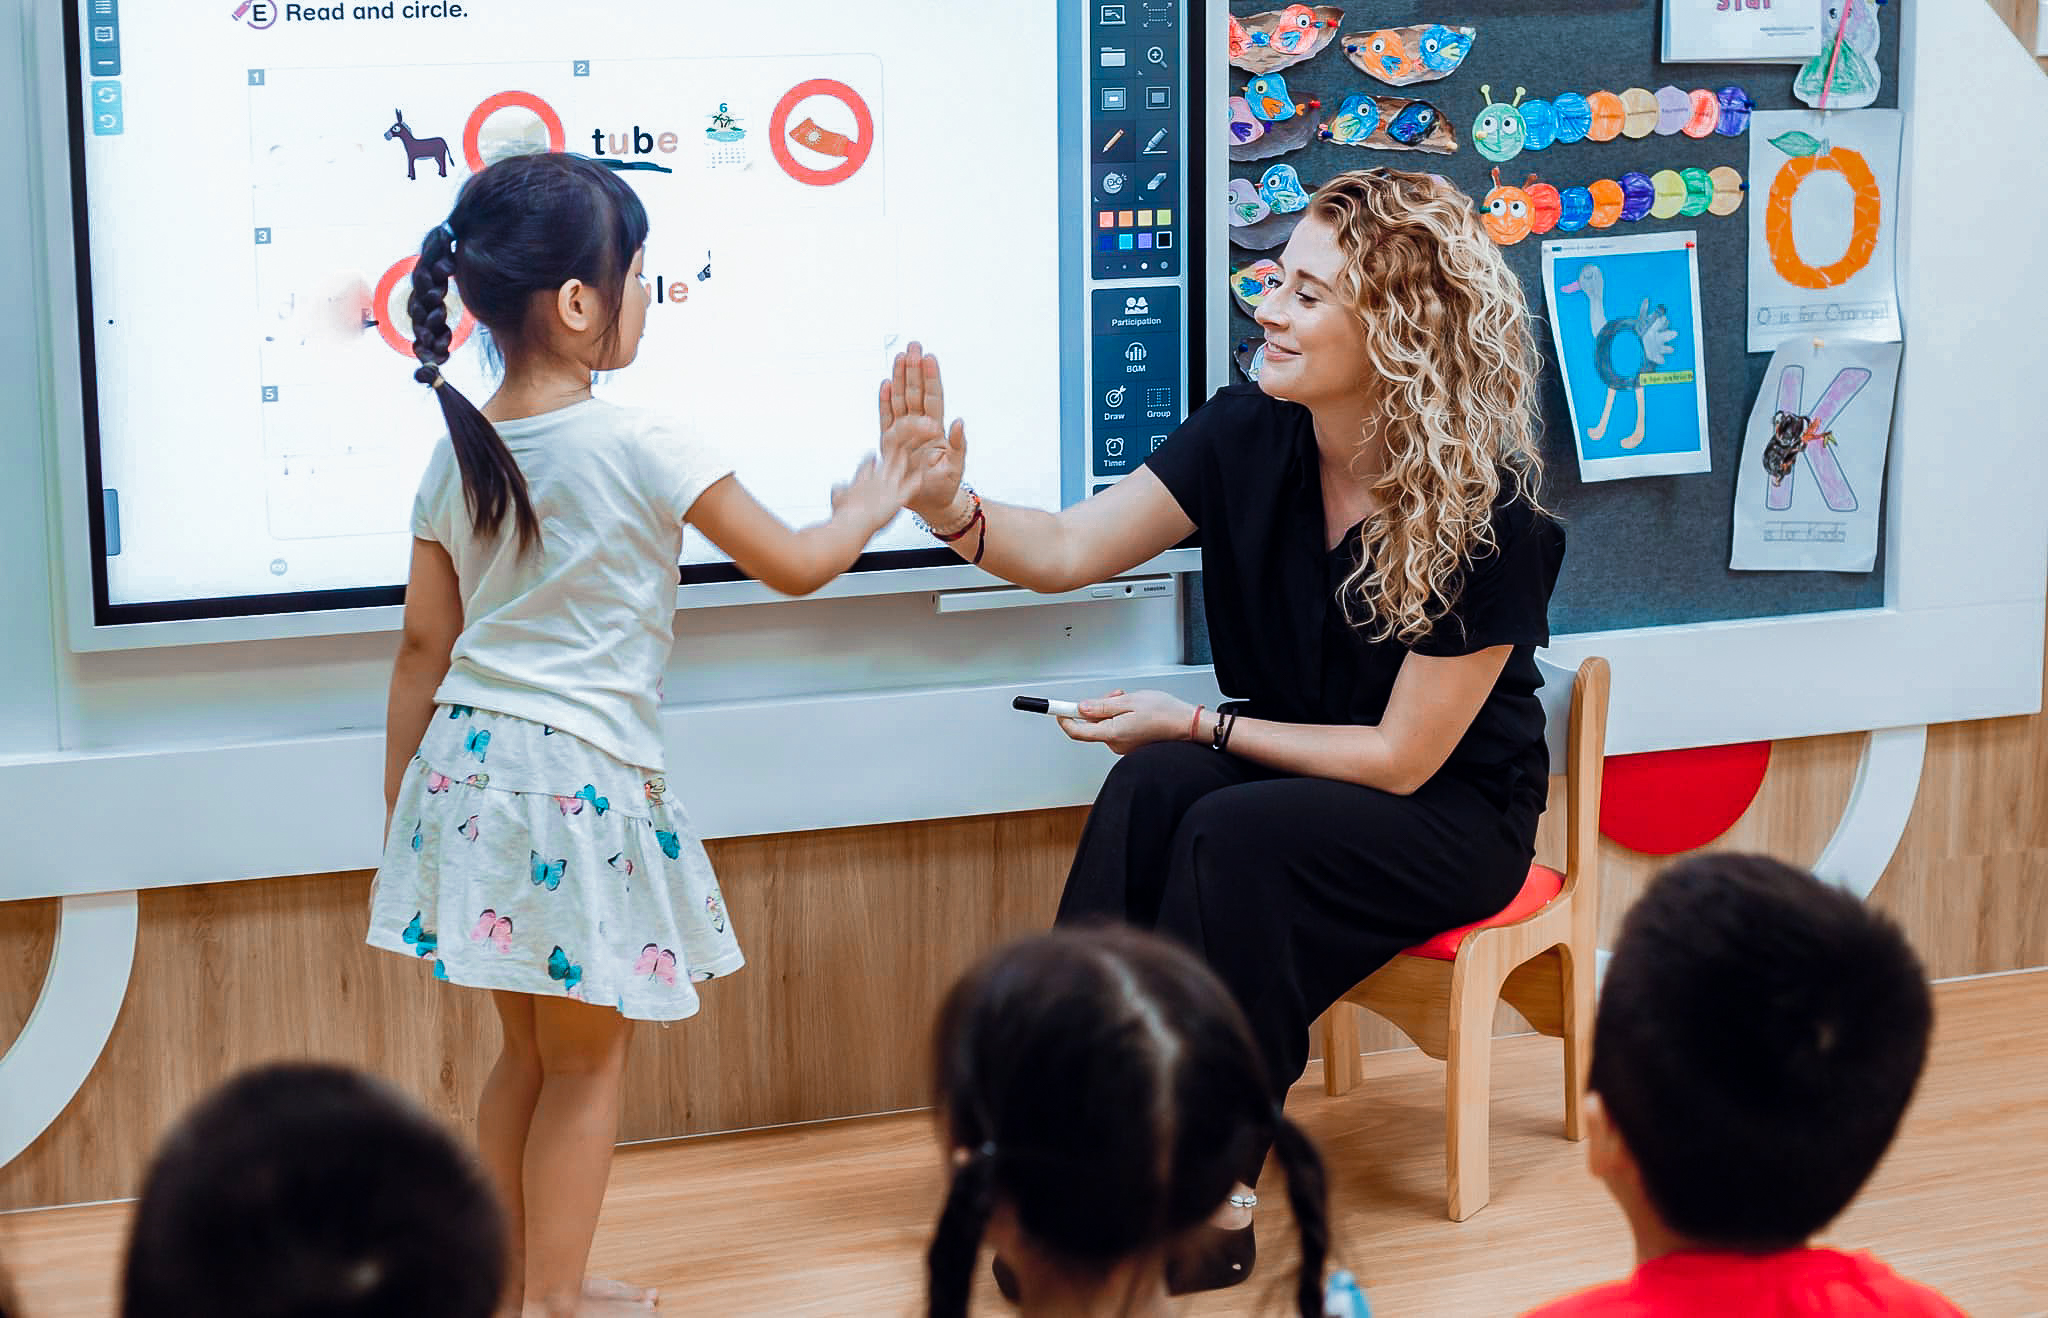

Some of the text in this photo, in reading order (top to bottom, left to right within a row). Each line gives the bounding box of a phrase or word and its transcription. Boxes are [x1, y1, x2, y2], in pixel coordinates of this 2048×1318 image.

[253, 0, 467, 22] E Read and circle.
[576, 63, 586, 74] 2
[719, 103, 728, 113] 6
[592, 126, 678, 155] tube
[1111, 318, 1162, 327] Participation
[1126, 365, 1146, 373] BGM
[1104, 410, 1171, 421] Draw Group
[1104, 459, 1126, 467] Timer
